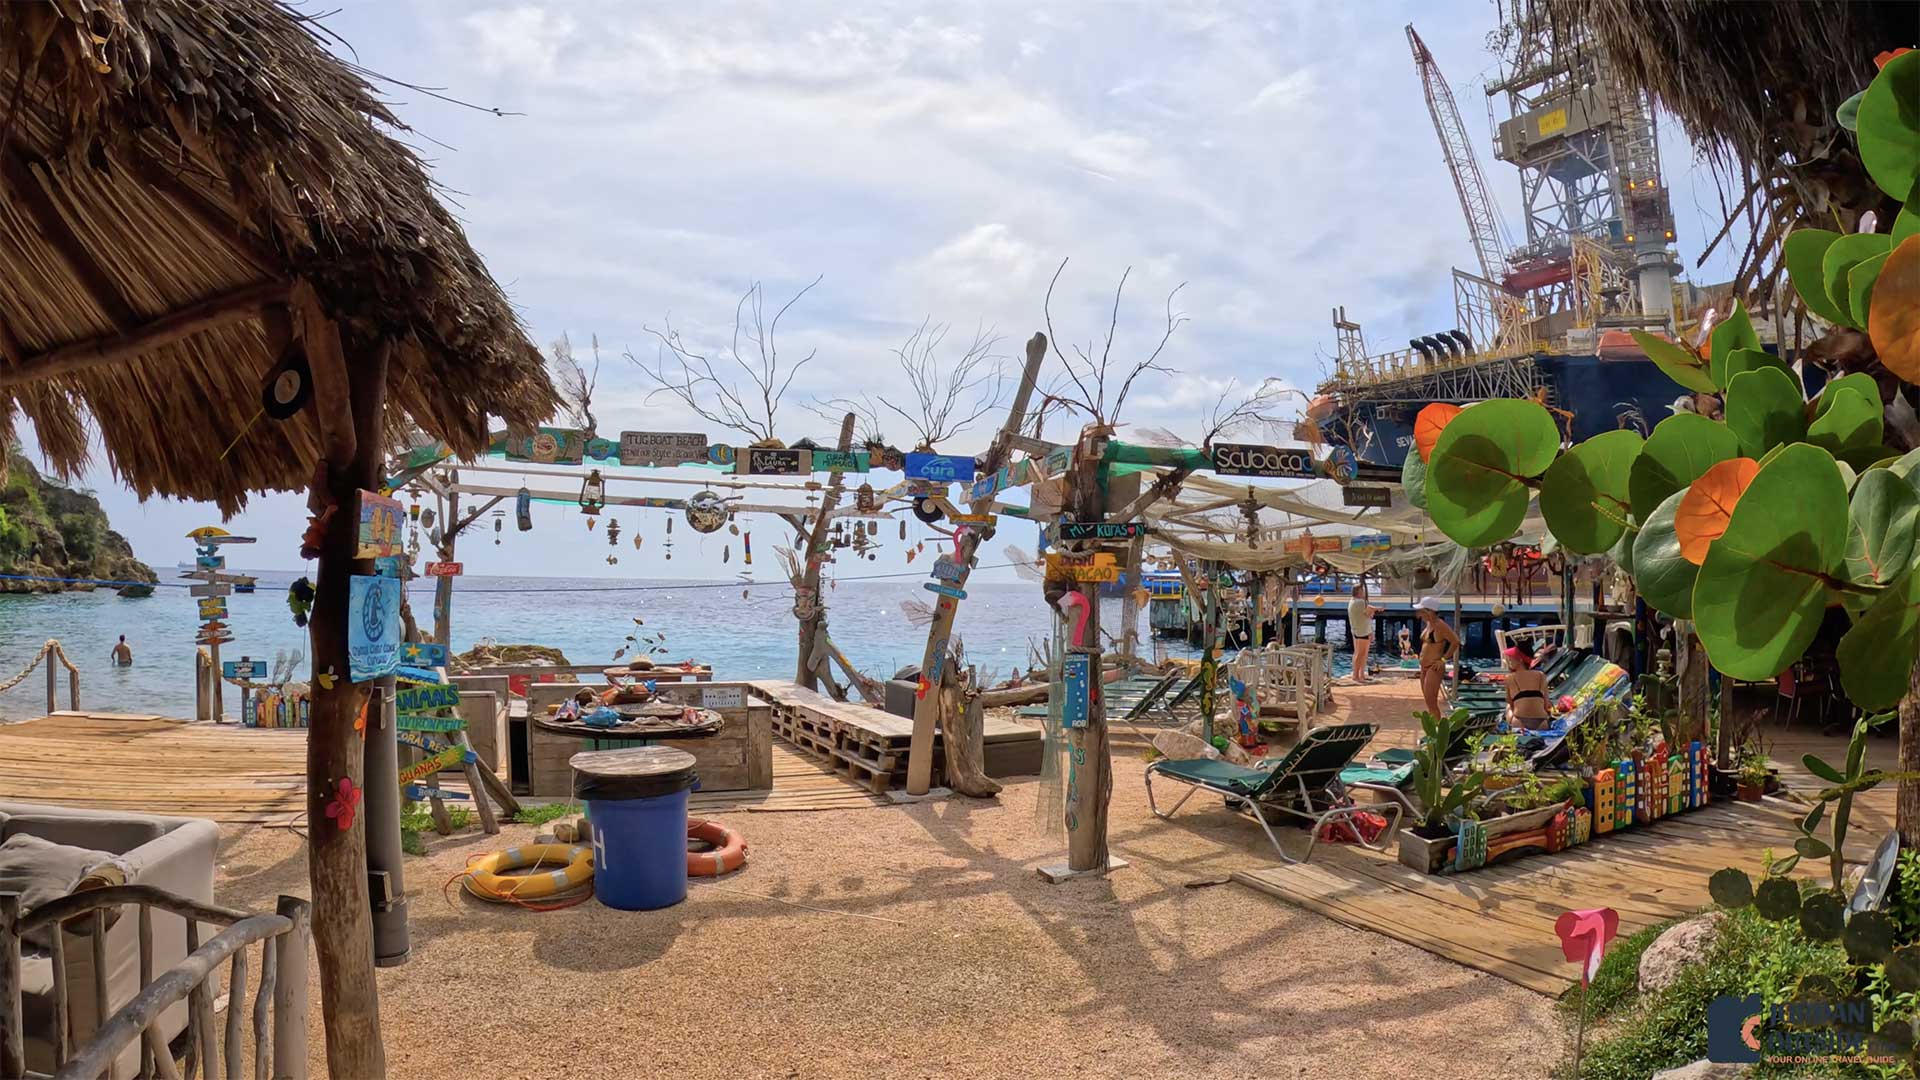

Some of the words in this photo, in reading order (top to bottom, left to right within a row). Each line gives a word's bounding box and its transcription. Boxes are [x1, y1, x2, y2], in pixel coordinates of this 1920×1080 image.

[627, 434, 648, 445] TUG
[650, 434, 673, 446] BOAT
[676, 435, 706, 447] BEACH
[920, 465, 955, 477] cura
[396, 684, 459, 710] ANIMALS
[397, 716, 462, 730] NVIRONMENT
[399, 756, 443, 785] GUANAS
